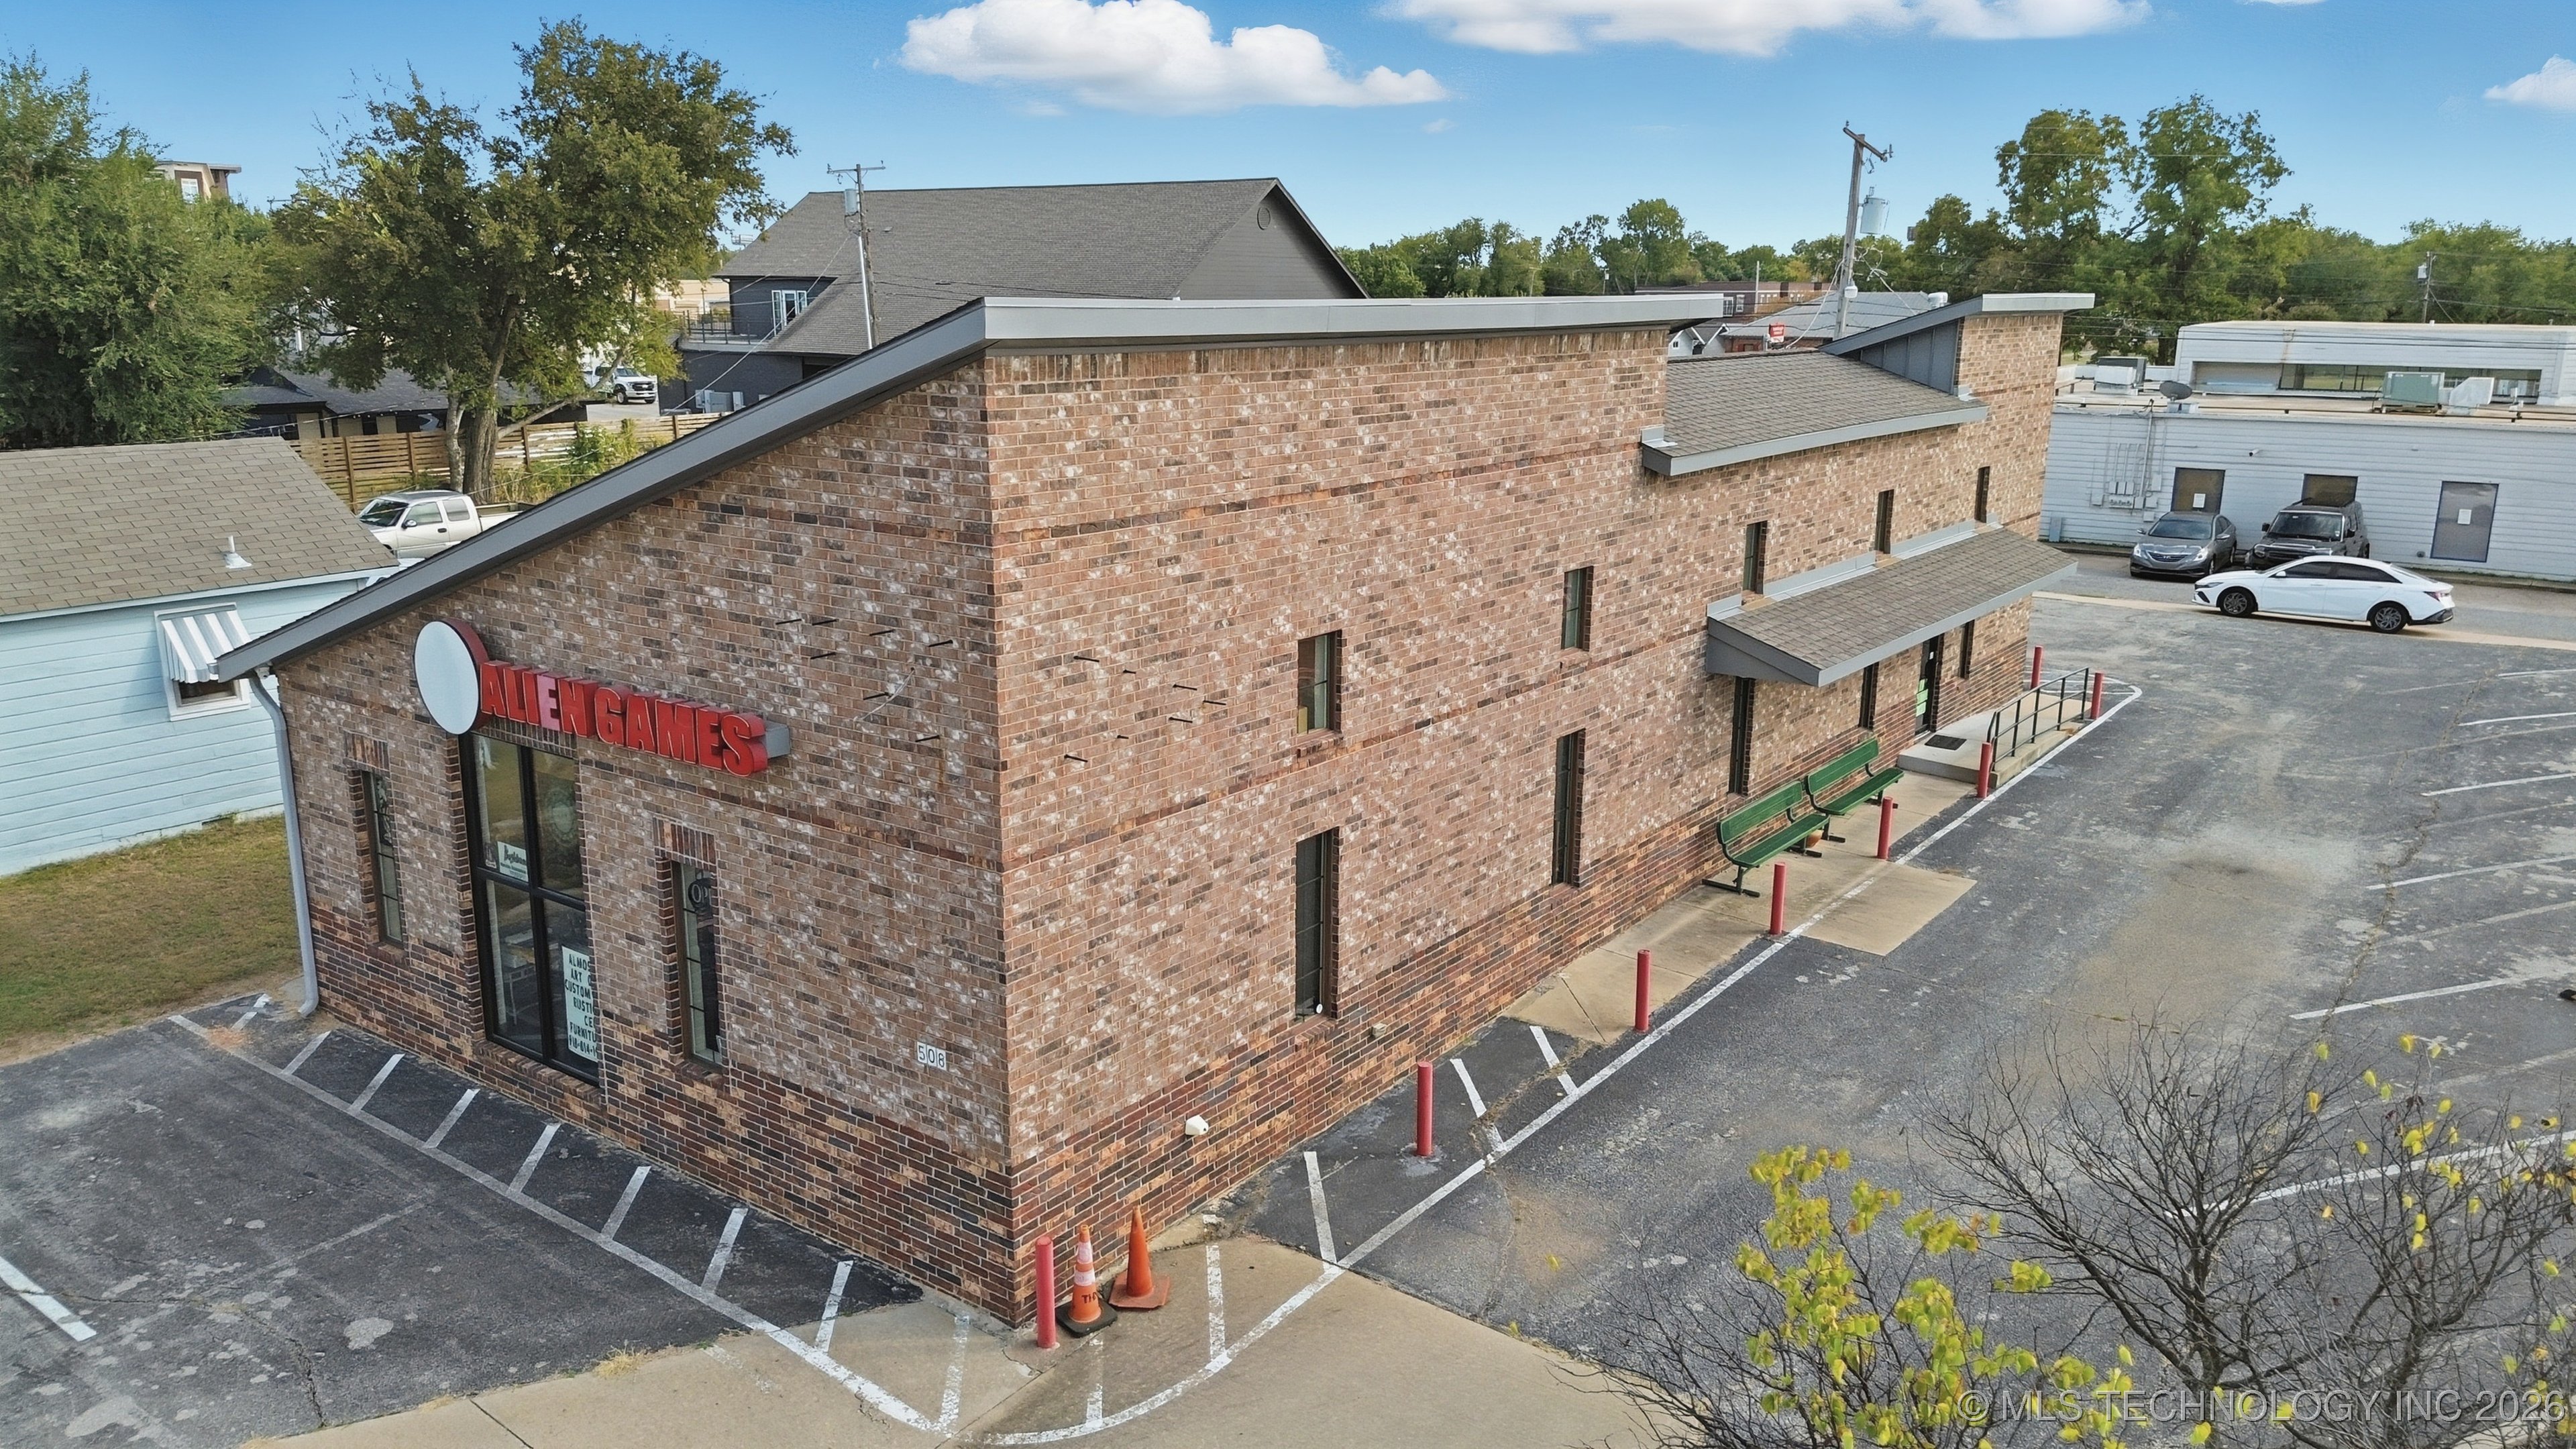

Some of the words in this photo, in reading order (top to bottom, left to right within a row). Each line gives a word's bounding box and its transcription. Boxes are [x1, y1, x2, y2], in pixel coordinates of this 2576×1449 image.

[480, 661, 596, 737] ALIEN
[594, 686, 767, 777] GAMES
[571, 968, 582, 983] ART
[565, 979, 591, 1000] CUSTOM
[918, 1044, 945, 1068] 508
